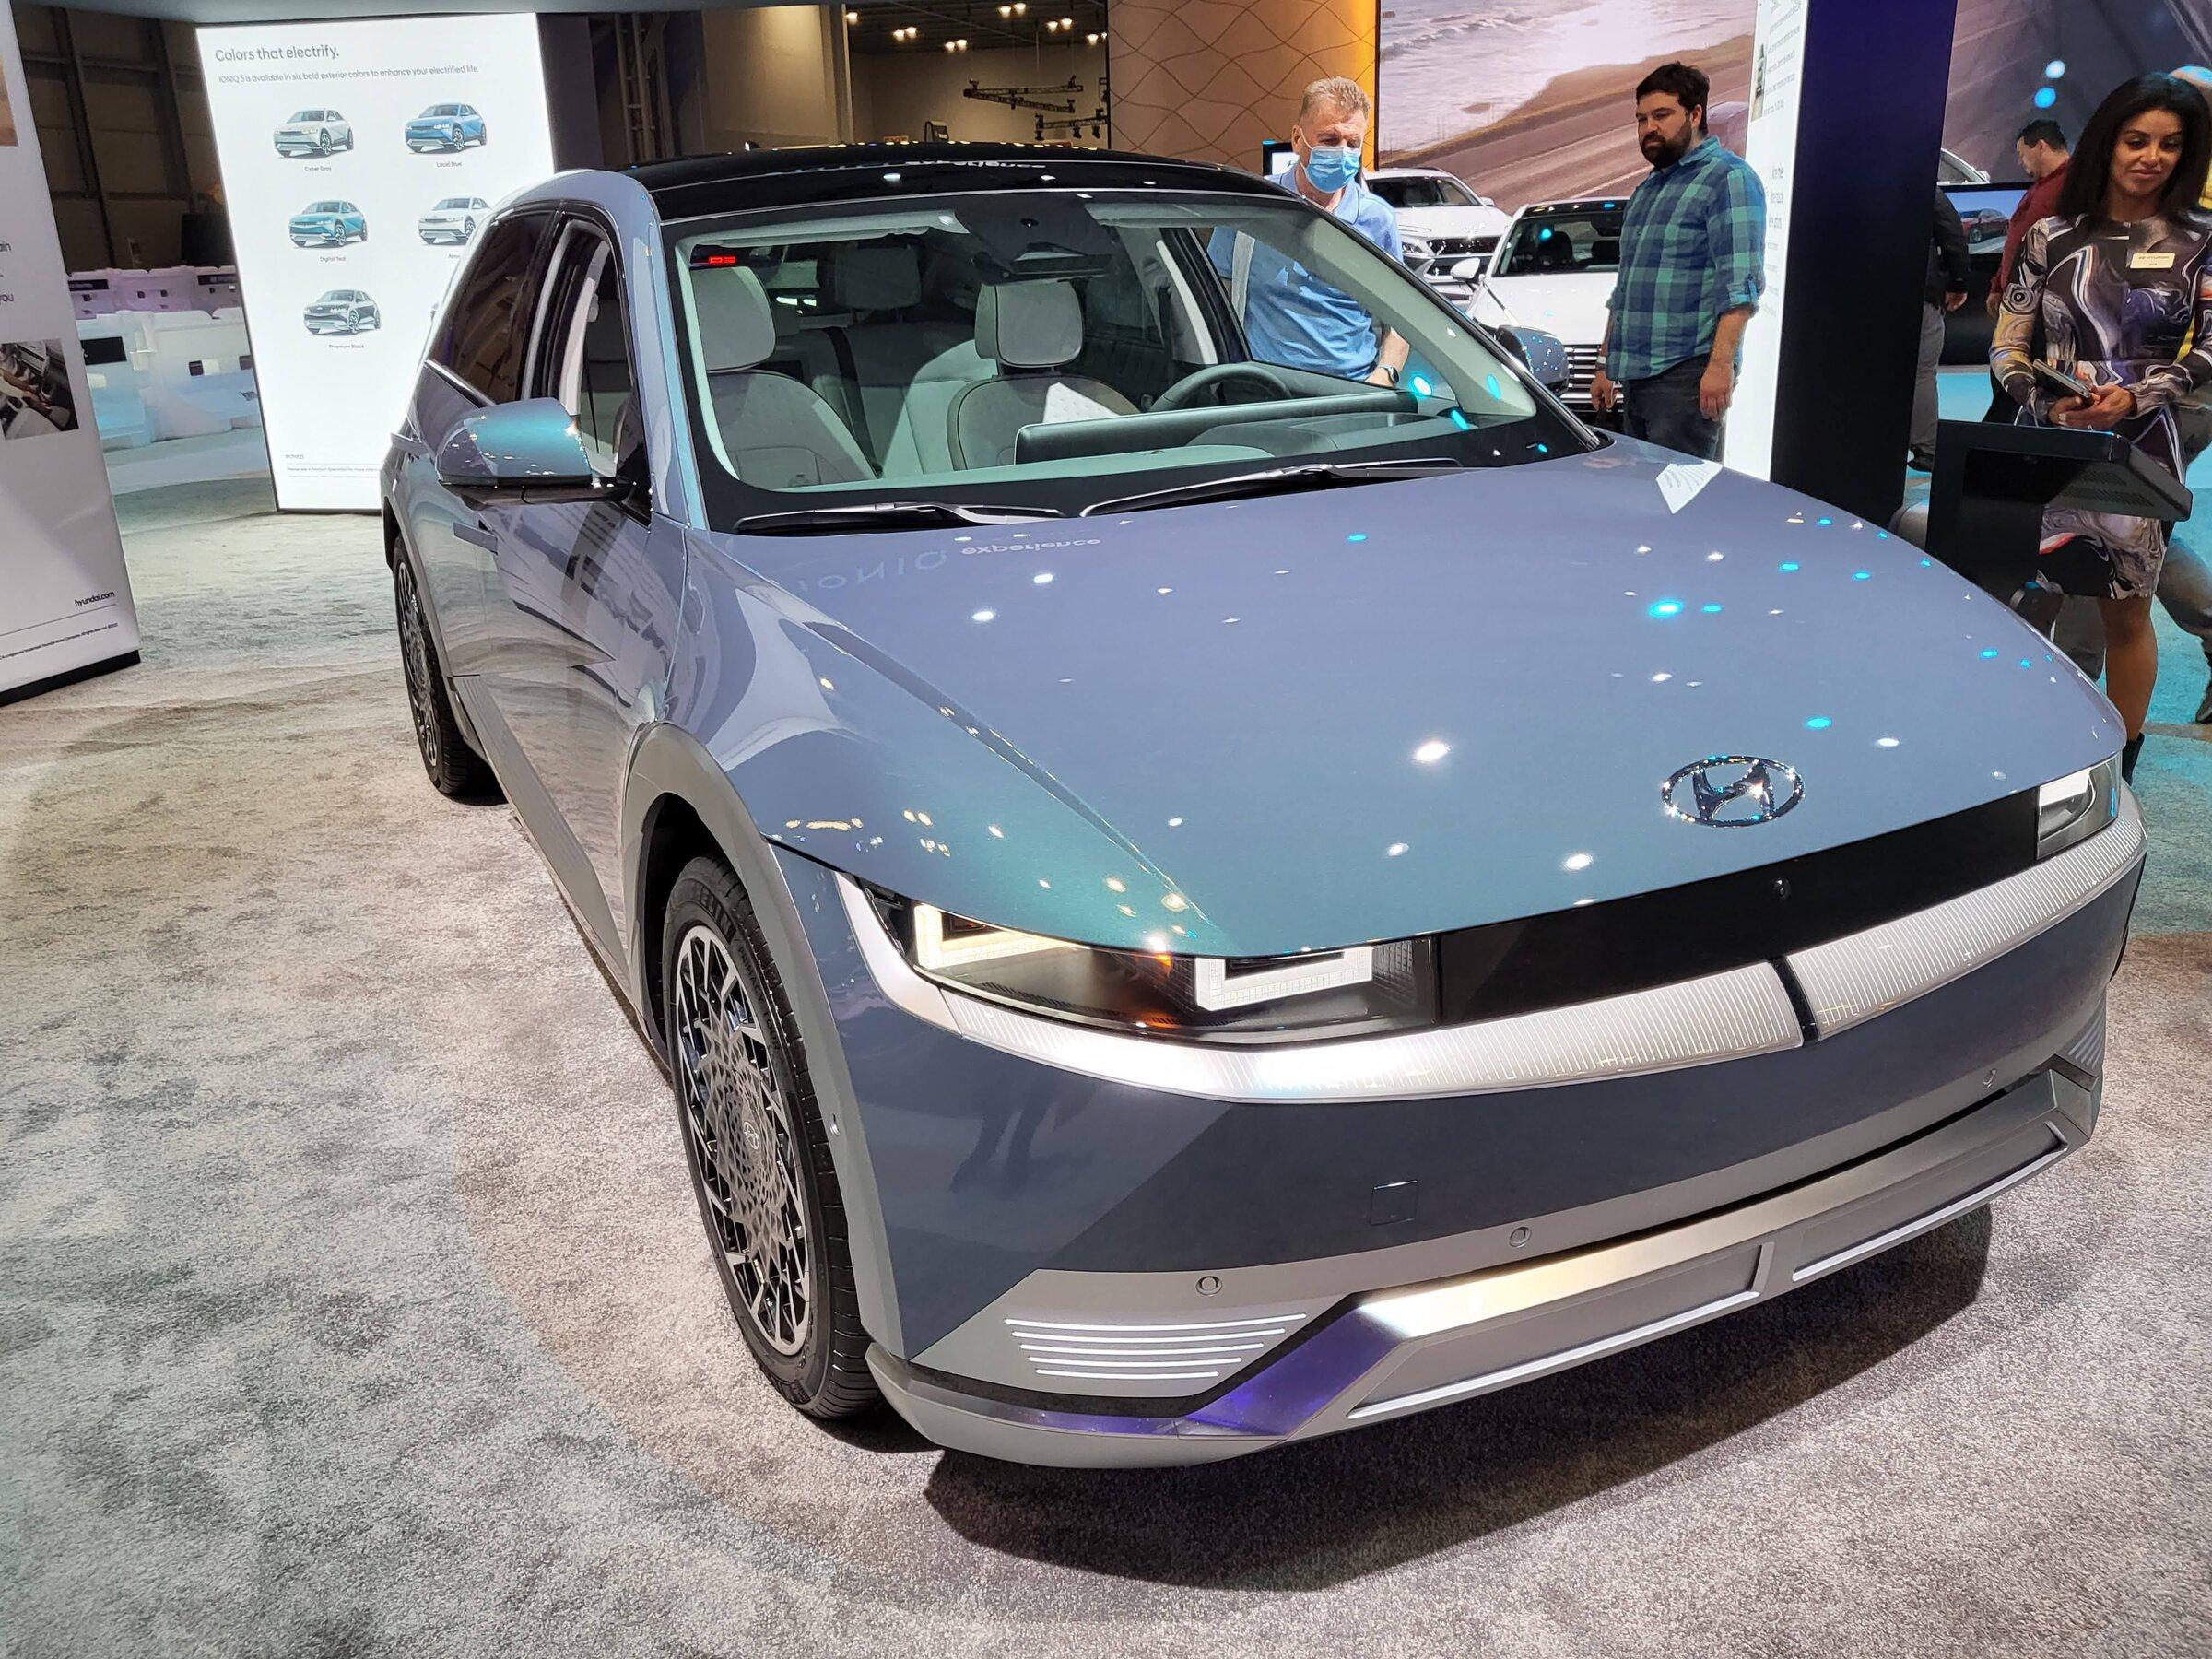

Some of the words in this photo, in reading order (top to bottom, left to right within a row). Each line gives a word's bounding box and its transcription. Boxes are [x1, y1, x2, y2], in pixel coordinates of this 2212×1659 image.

[215, 48, 254, 62] Colors
[256, 47, 283, 60] that
[286, 44, 340, 60] electrify.
[252, 73, 283, 82] available
[292, 73, 301, 81] six
[302, 71, 319, 80] bold
[321, 71, 347, 79] exterior
[348, 69, 370, 78] colors
[371, 69, 379, 77] to
[380, 68, 411, 76] enhance
[411, 66, 428, 76] your
[429, 65, 465, 74] electrified
[75, 591, 115, 606] hyundai.com
